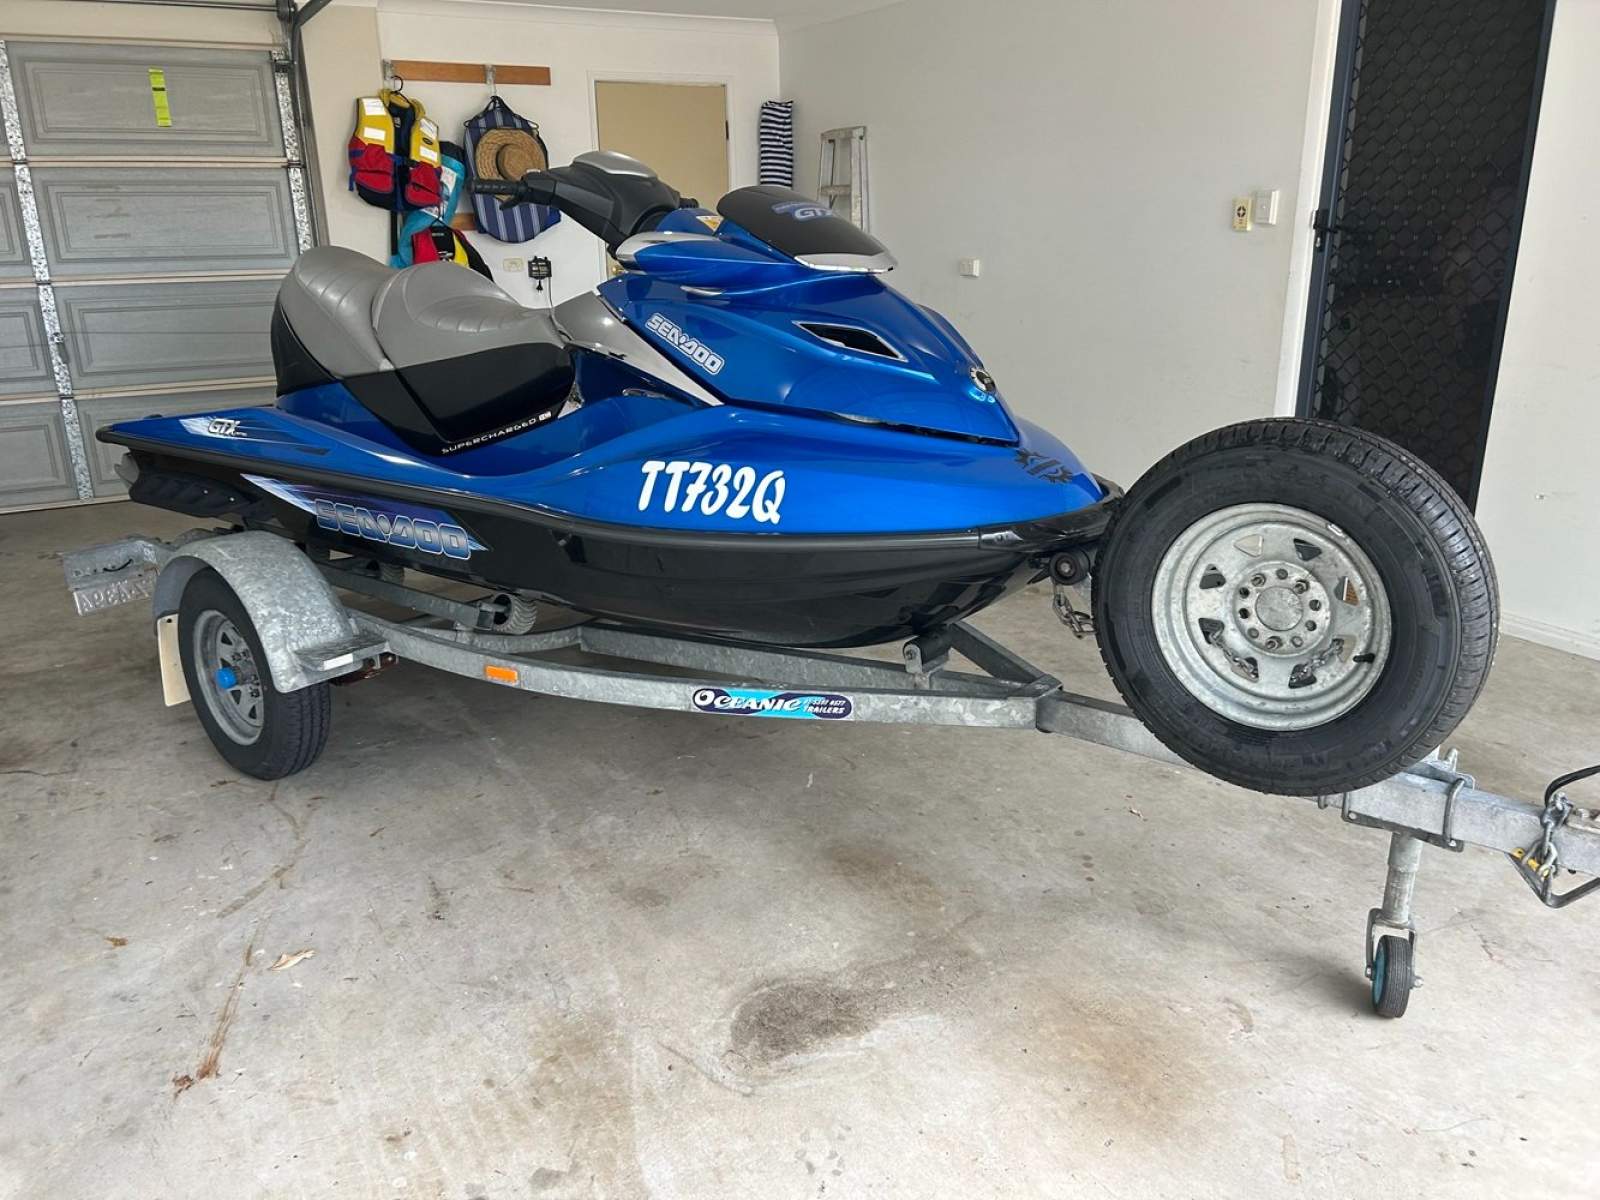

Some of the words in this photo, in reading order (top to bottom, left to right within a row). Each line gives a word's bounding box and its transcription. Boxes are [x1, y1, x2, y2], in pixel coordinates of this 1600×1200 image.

[441, 419, 537, 454] SUPERCHARGED
[638, 460, 786, 525] TT732Q
[694, 689, 801, 711] OCEANIC
